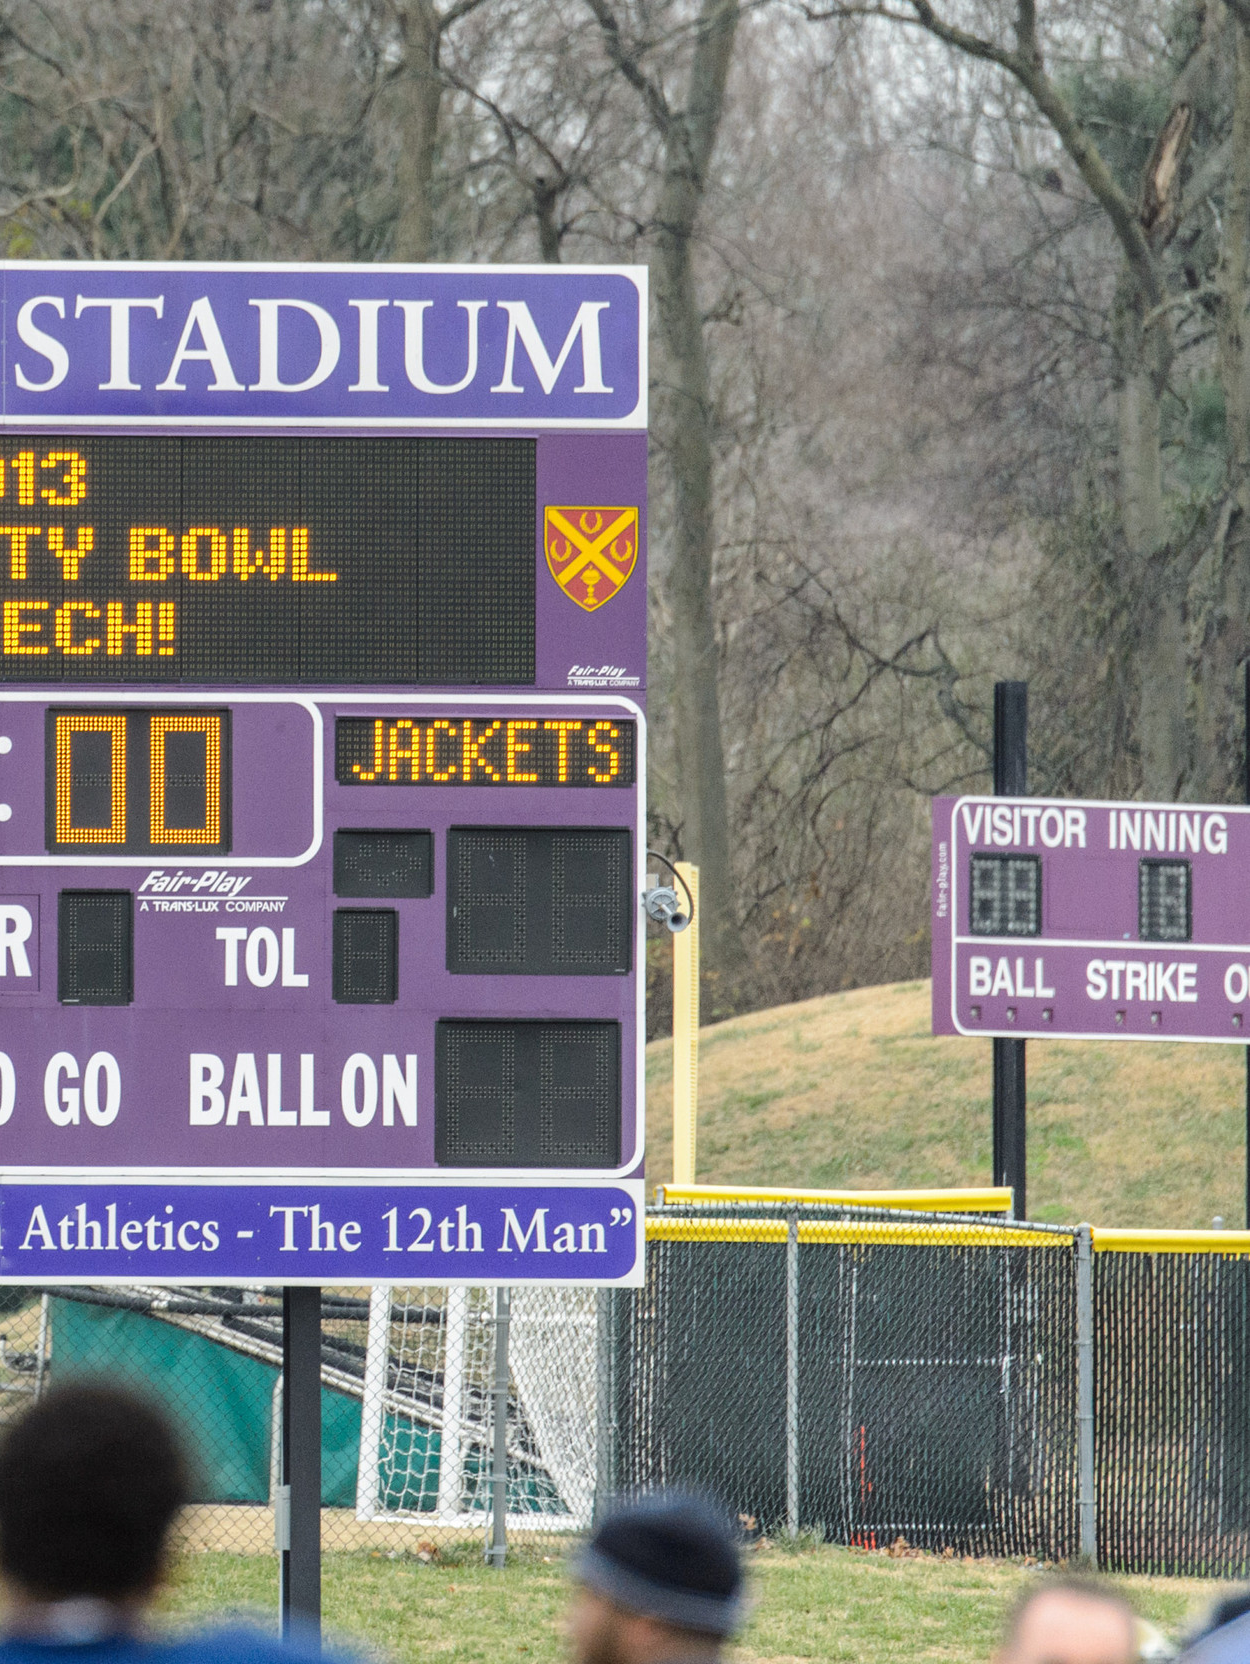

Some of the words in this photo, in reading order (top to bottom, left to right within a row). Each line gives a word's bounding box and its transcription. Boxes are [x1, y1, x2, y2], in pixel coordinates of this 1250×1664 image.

[14, 294, 614, 395] STADIUM
[129, 526, 338, 582] BOWL
[352, 719, 619, 783] JACKETS
[961, 805, 1087, 849] VISITOR
[1109, 810, 1228, 854] INNING
[138, 870, 253, 897] Fair-Play
[140, 901, 149, 912] A
[225, 901, 286, 912] COMPANY
[215, 927, 309, 988] TOL
[969, 956, 1056, 998] BALL
[1086, 959, 1199, 1003] STRIKE
[1224, 963, 1250, 1004] O
[44, 1051, 121, 1127] GO
[189, 1052, 330, 1127] BALL
[340, 1053, 418, 1127] ON
[20, 1204, 221, 1252] Athletics
[269, 1205, 361, 1252] The
[382, 1206, 483, 1253] 12th
